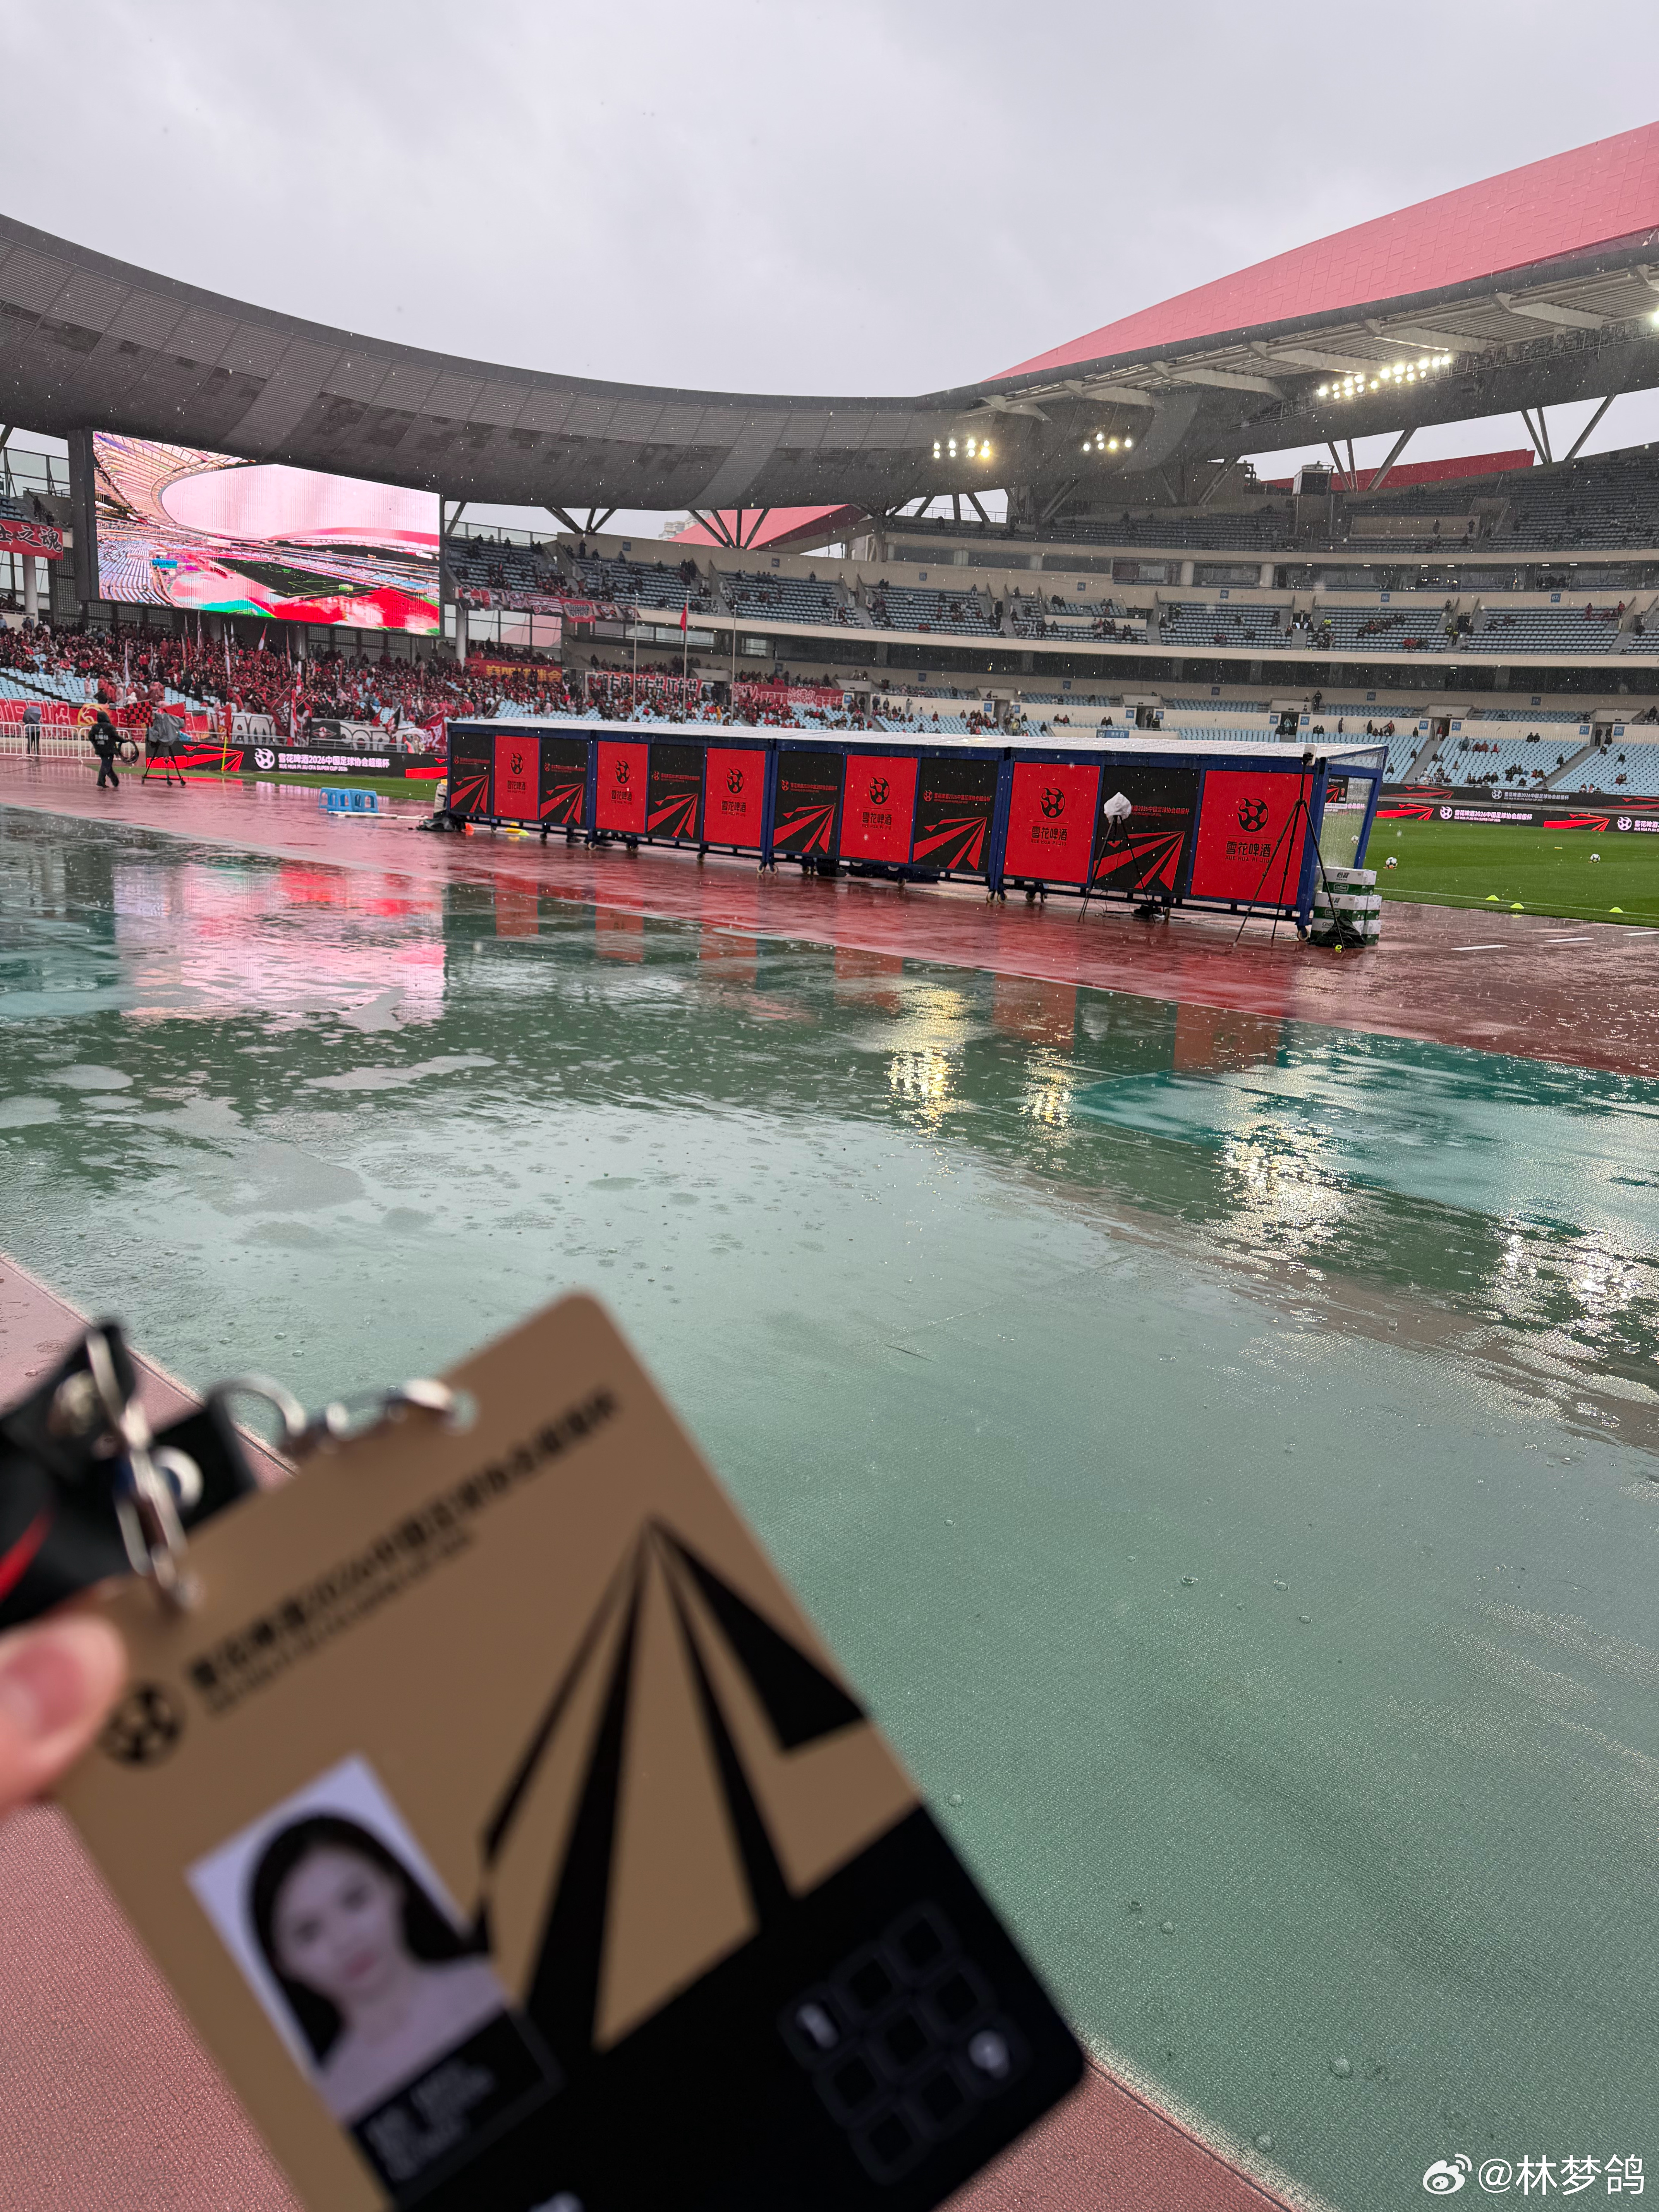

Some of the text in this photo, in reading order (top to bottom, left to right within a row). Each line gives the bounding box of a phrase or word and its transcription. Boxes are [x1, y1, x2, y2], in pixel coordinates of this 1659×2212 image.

[278, 753, 390, 768] 雪花啤酒2026中国足球协会超级杯
[862, 812, 892, 825] 雪花啤酒
[1455, 809, 1532, 820] 雪花啤酒2026中国足球协会超级杯
[1032, 826, 1067, 841] 雪花啤酒
[1226, 841, 1271, 857] 雪花啤酒
